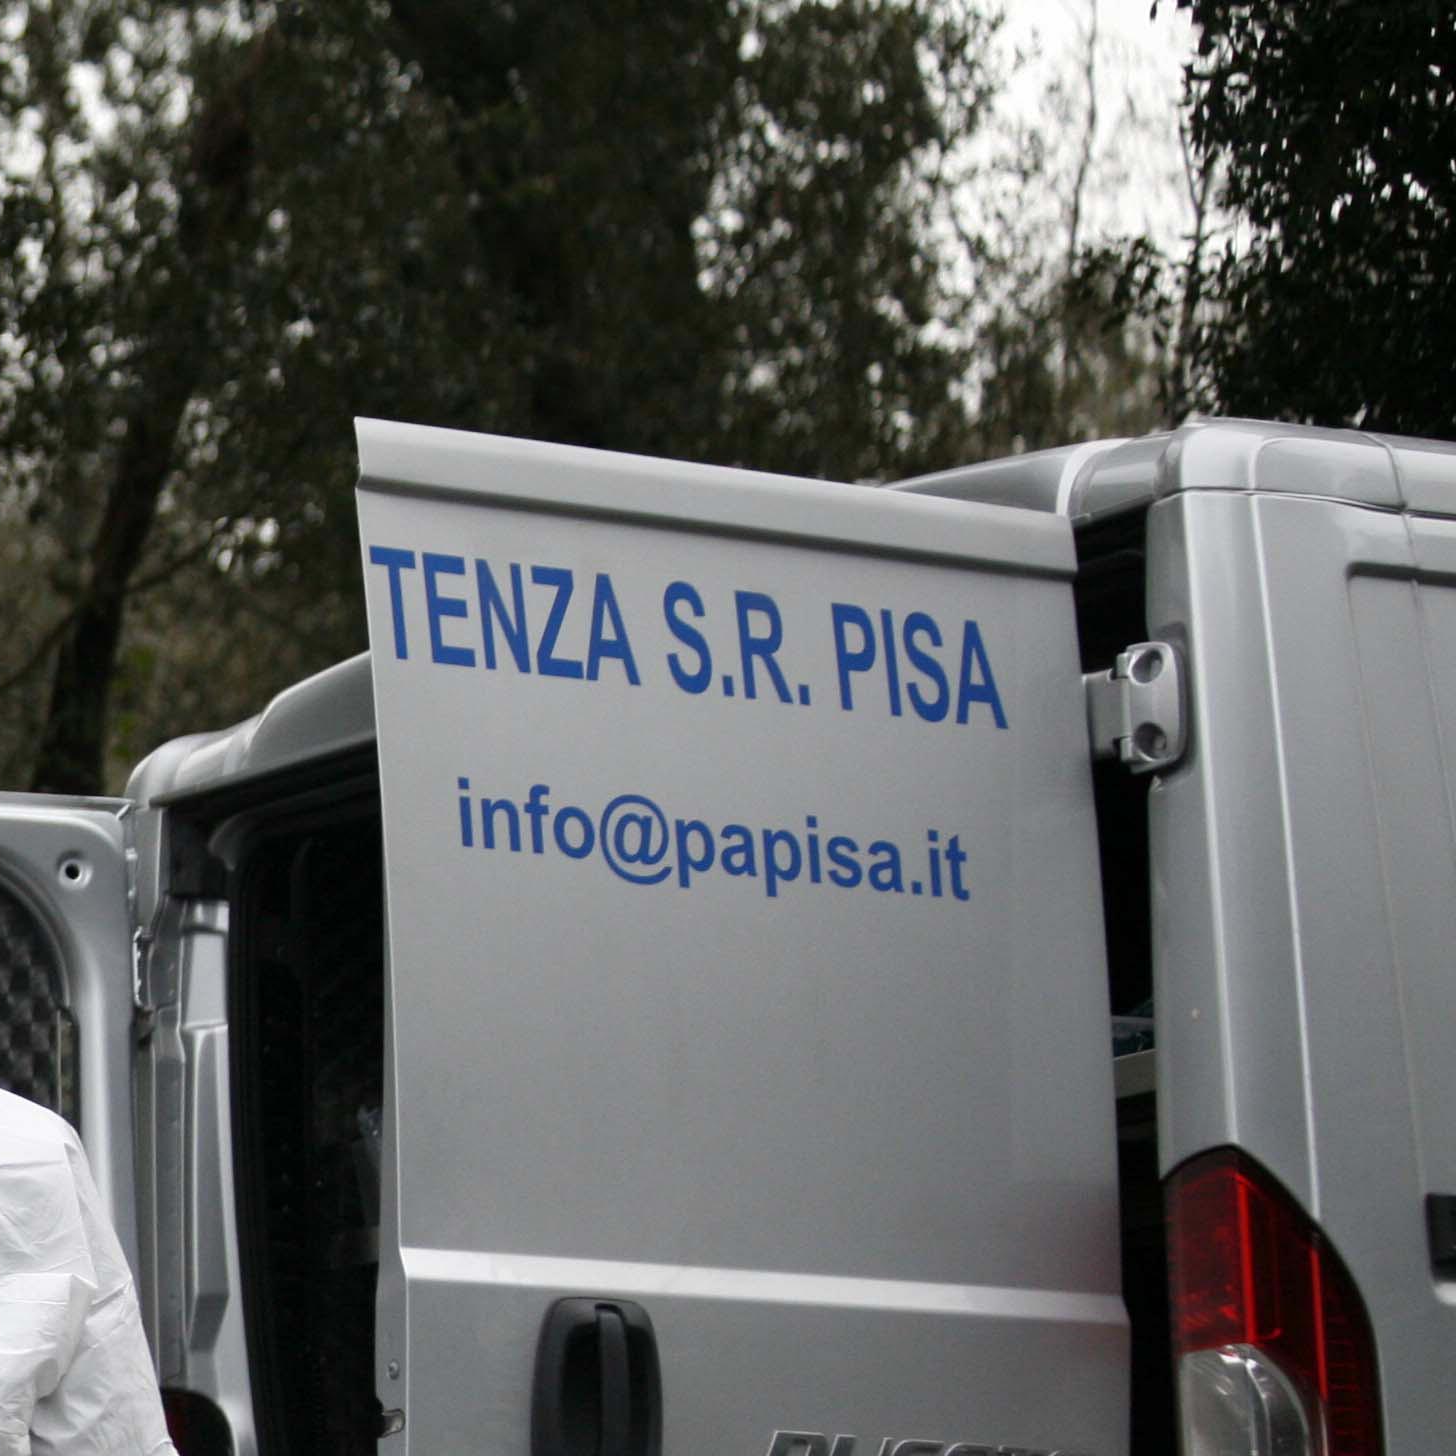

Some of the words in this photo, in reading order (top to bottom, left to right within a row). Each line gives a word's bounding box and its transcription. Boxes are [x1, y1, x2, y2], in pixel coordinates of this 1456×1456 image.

[369, 545, 641, 686] TENZA
[663, 581, 811, 706] S.R.
[832, 603, 1008, 729] PISA
[458, 776, 970, 901] info@papisa.it
